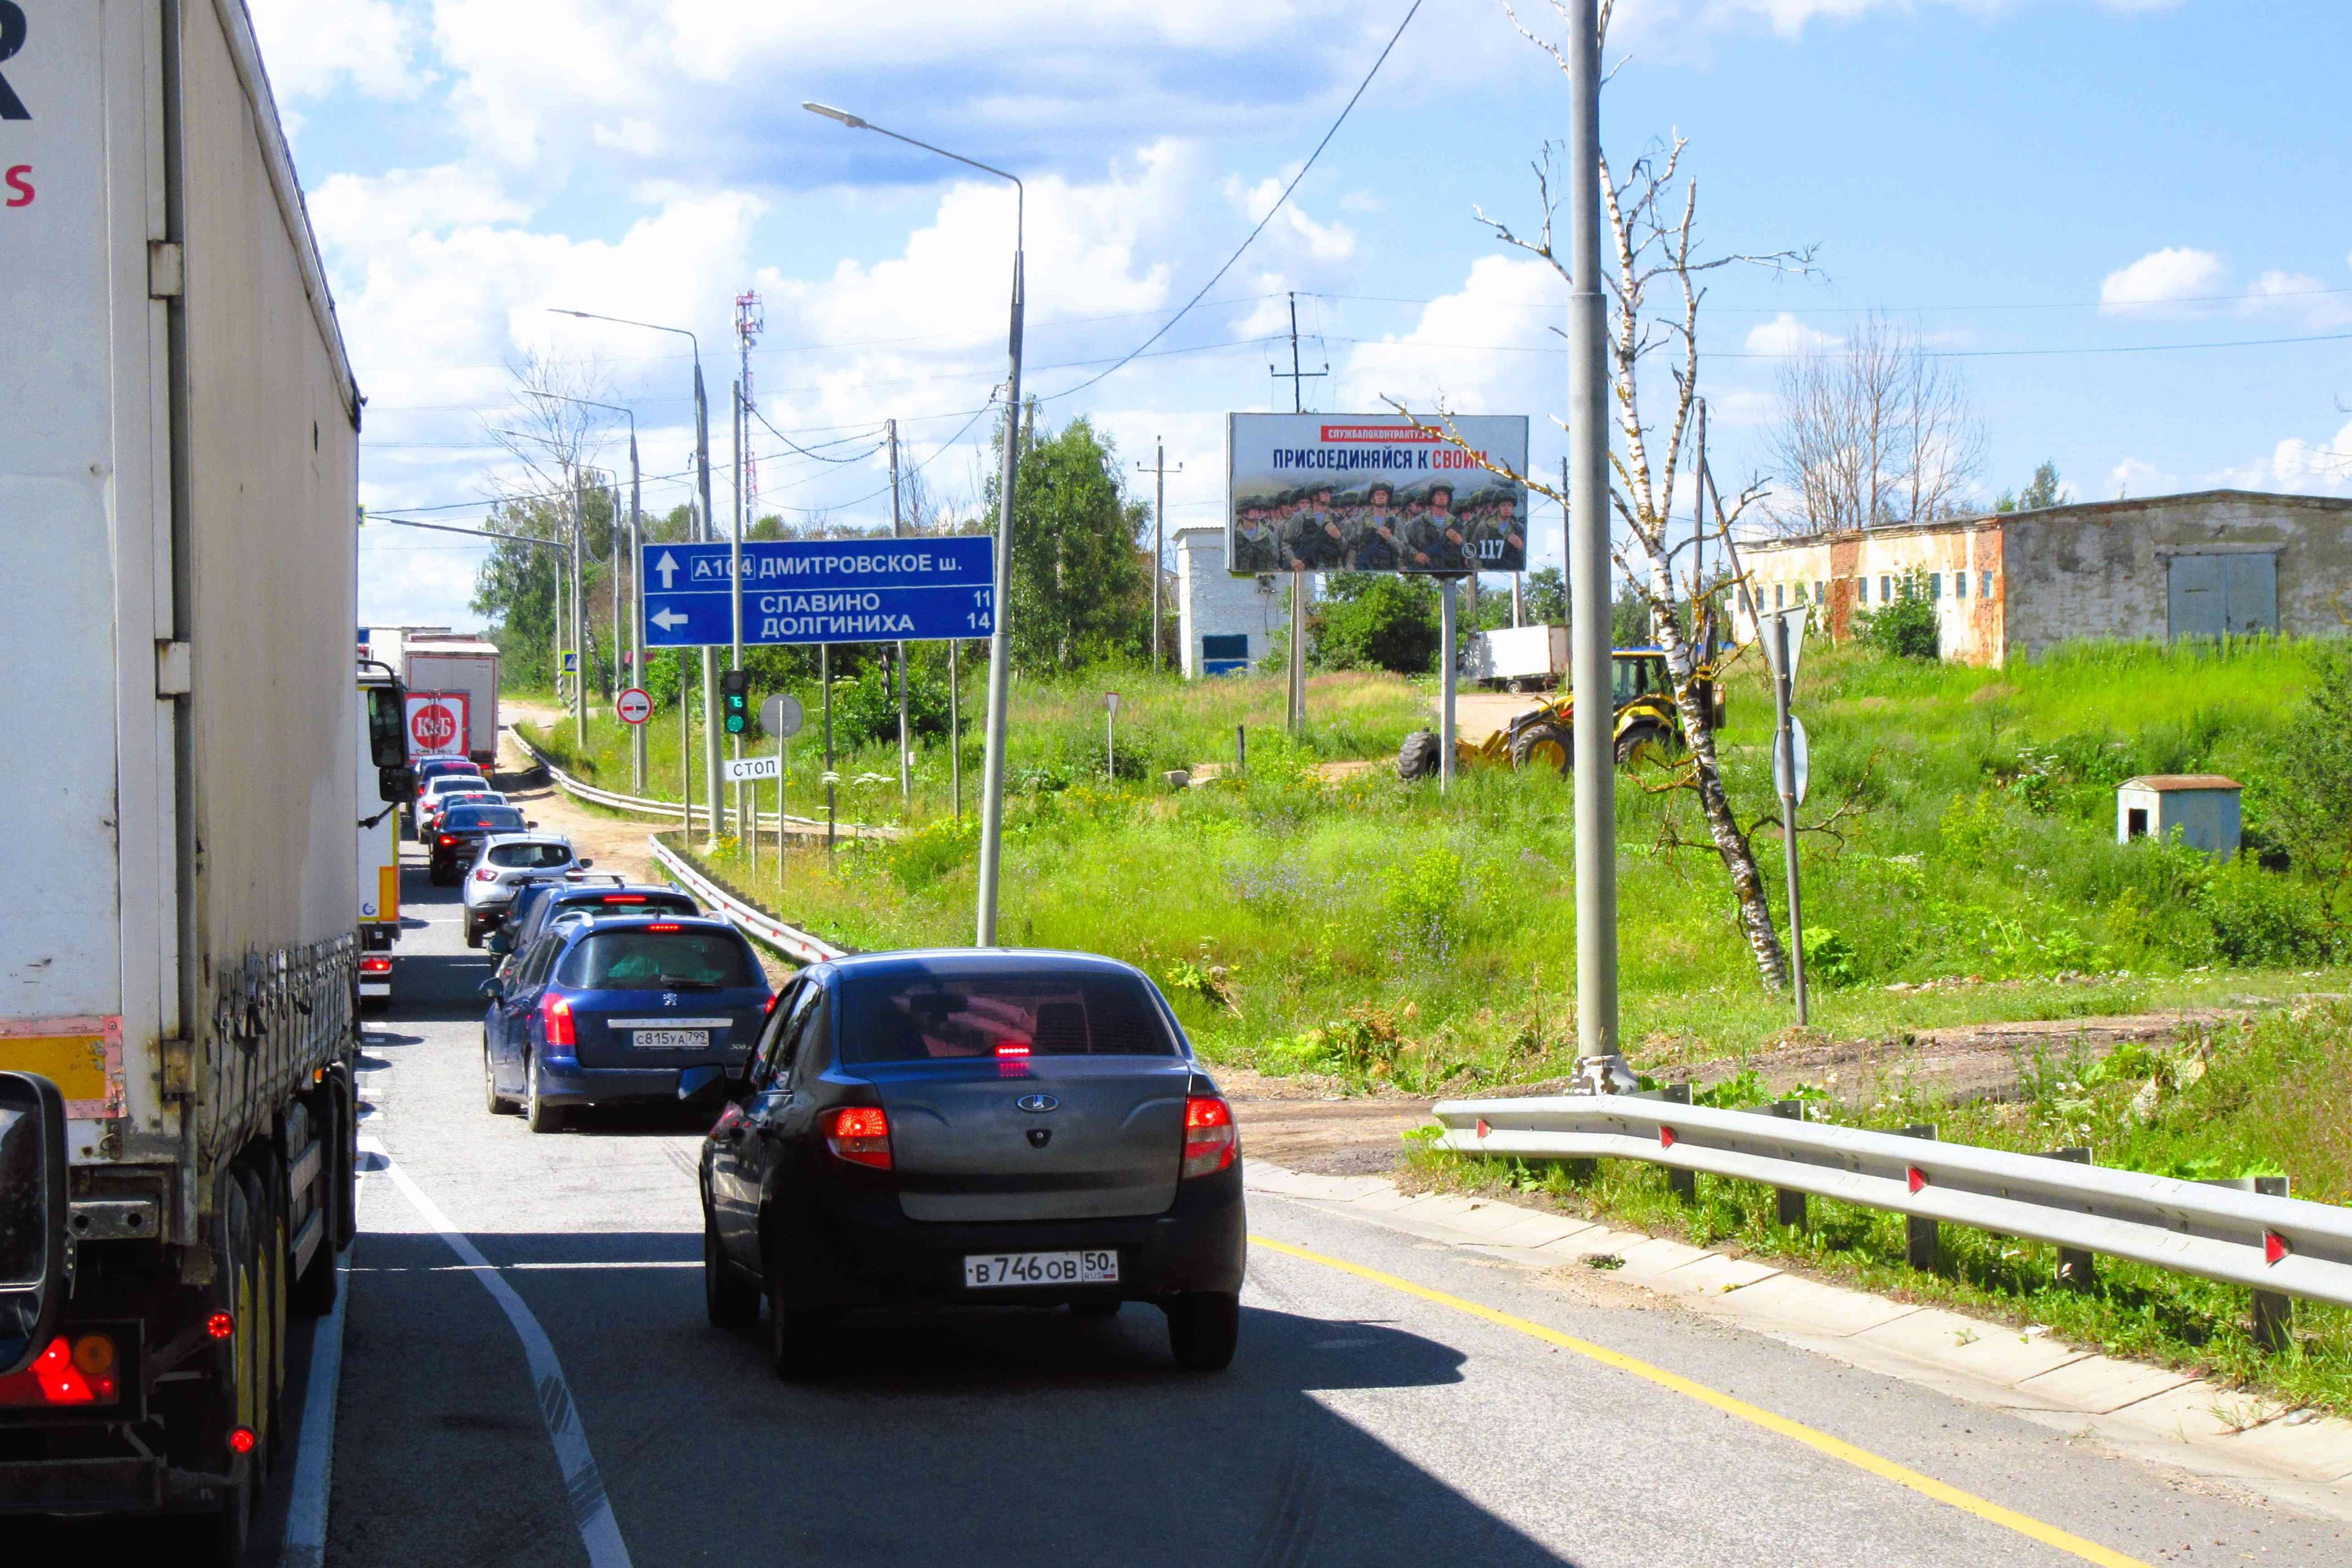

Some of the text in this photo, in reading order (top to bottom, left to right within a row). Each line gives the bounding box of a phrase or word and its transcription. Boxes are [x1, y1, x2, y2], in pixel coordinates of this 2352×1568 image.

[1273, 446, 1412, 471] ПРИСОЕДИНЯЙСЯ
[1418, 450, 1428, 469] К
[1479, 540, 1505, 559] 117
[759, 554, 932, 579] ДМИТРОВСКОЕ
[760, 590, 990, 613] СЛАВИНО 11
[761, 612, 990, 638] ДОЛГИНИХА 14
[733, 760, 775, 777] СТОП
[1085, 1253, 1109, 1271] 50
